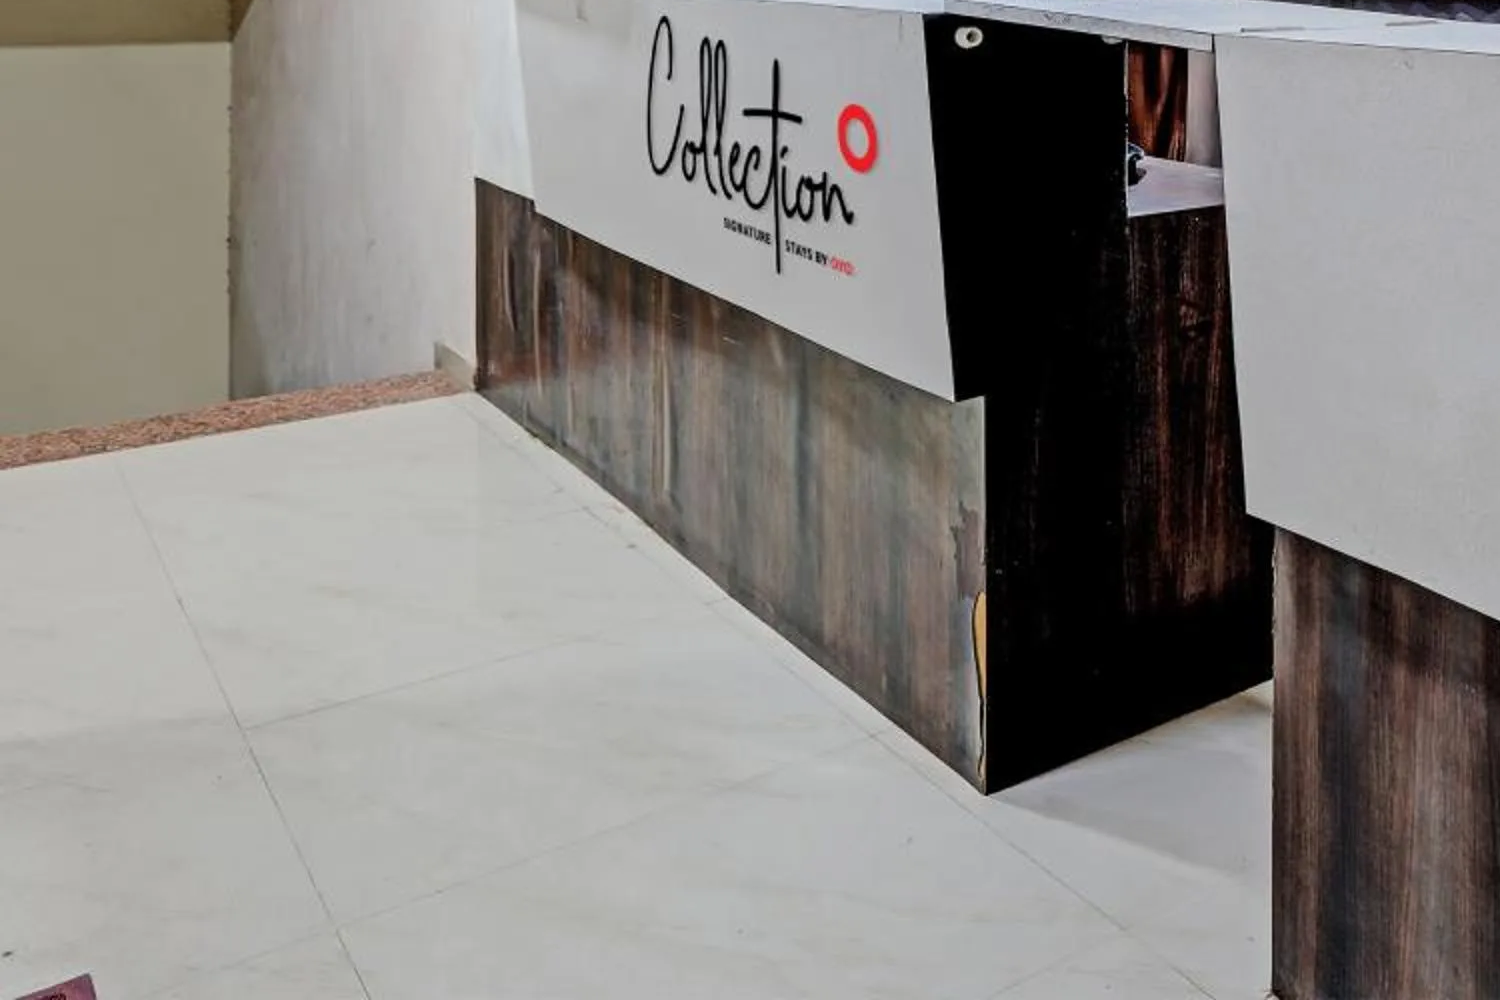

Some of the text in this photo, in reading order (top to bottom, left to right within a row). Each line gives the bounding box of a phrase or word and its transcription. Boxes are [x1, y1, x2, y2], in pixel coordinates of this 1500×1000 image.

[646, 15, 855, 275] Collection
[723, 217, 772, 245] SIGNATURE
[785, 239, 813, 261] STAYS
[815, 250, 829, 266] BY
